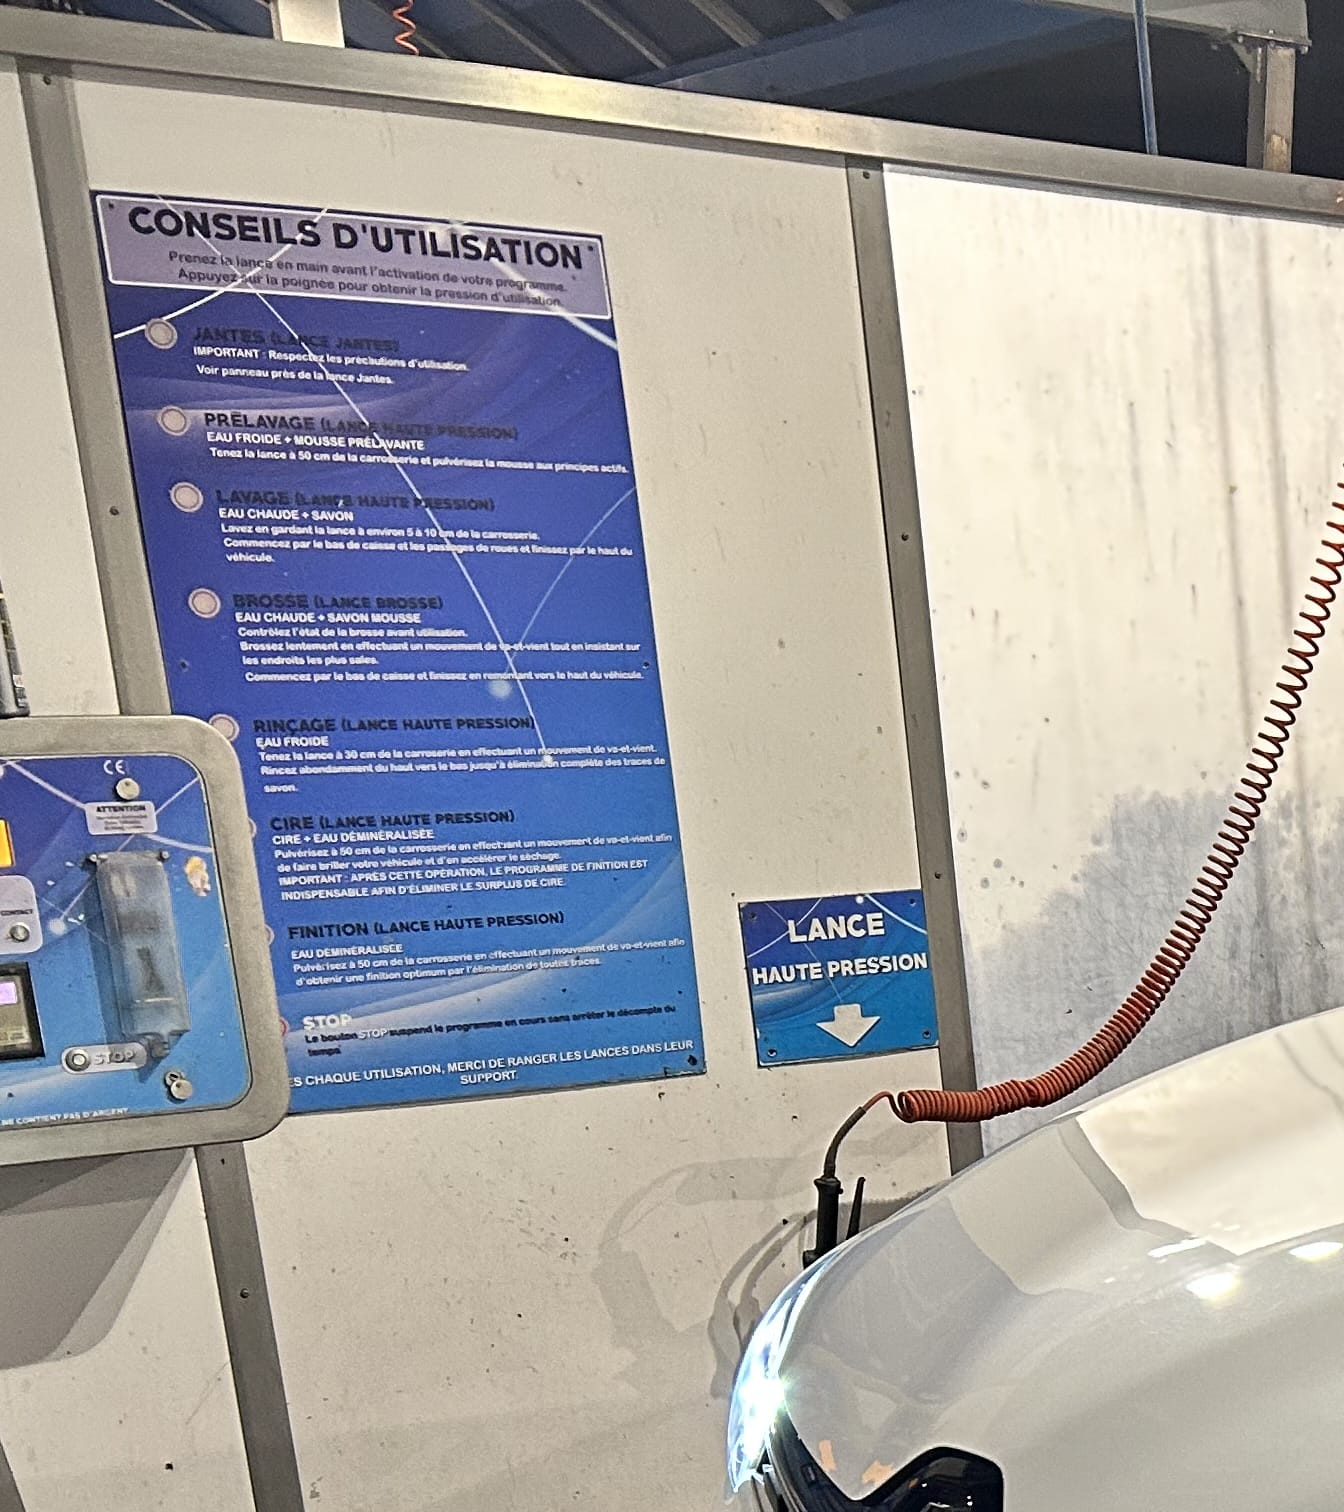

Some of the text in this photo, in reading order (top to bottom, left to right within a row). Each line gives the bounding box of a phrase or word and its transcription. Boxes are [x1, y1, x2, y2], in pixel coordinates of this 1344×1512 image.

[128, 206, 582, 269] CONSEILS D'UTILISATION
[206, 431, 233, 443] EAU
[235, 432, 282, 444] FROIDE
[293, 435, 346, 447] MOUSSE
[219, 507, 245, 519] EAU
[246, 508, 300, 520] CHAUDE
[311, 510, 354, 521] SAVON
[235, 612, 262, 622] EAU
[263, 612, 316, 622] CHAUDE
[327, 612, 369, 623] SAVON
[371, 613, 421, 623] MOUSSE
[253, 717, 535, 736] RINÇAGE (LANCE HAUTE PRESSION)
[255, 736, 329, 747] EAU FROIDE
[270, 810, 515, 831] CIRE (LANCE HAUTE PRESSION)
[288, 912, 565, 939] FINITION (LANCE HAUTE PRESSION)
[787, 912, 885, 943] LANCE
[752, 953, 928, 985] HAUTE PRESSION
[302, 1013, 353, 1030] STOP
[94, 1050, 136, 1065] STOP
[305, 1070, 361, 1086] CHAQUE
[363, 1063, 445, 1082] UTILISATION,
[447, 1059, 486, 1072] MERCI
[488, 1057, 505, 1068] DE
[507, 1052, 557, 1066] RANGER
[559, 1050, 582, 1061] LES
[583, 1045, 629, 1059] LANCES
[631, 1042, 662, 1055] DANS
[663, 1039, 693, 1051] LEUR
